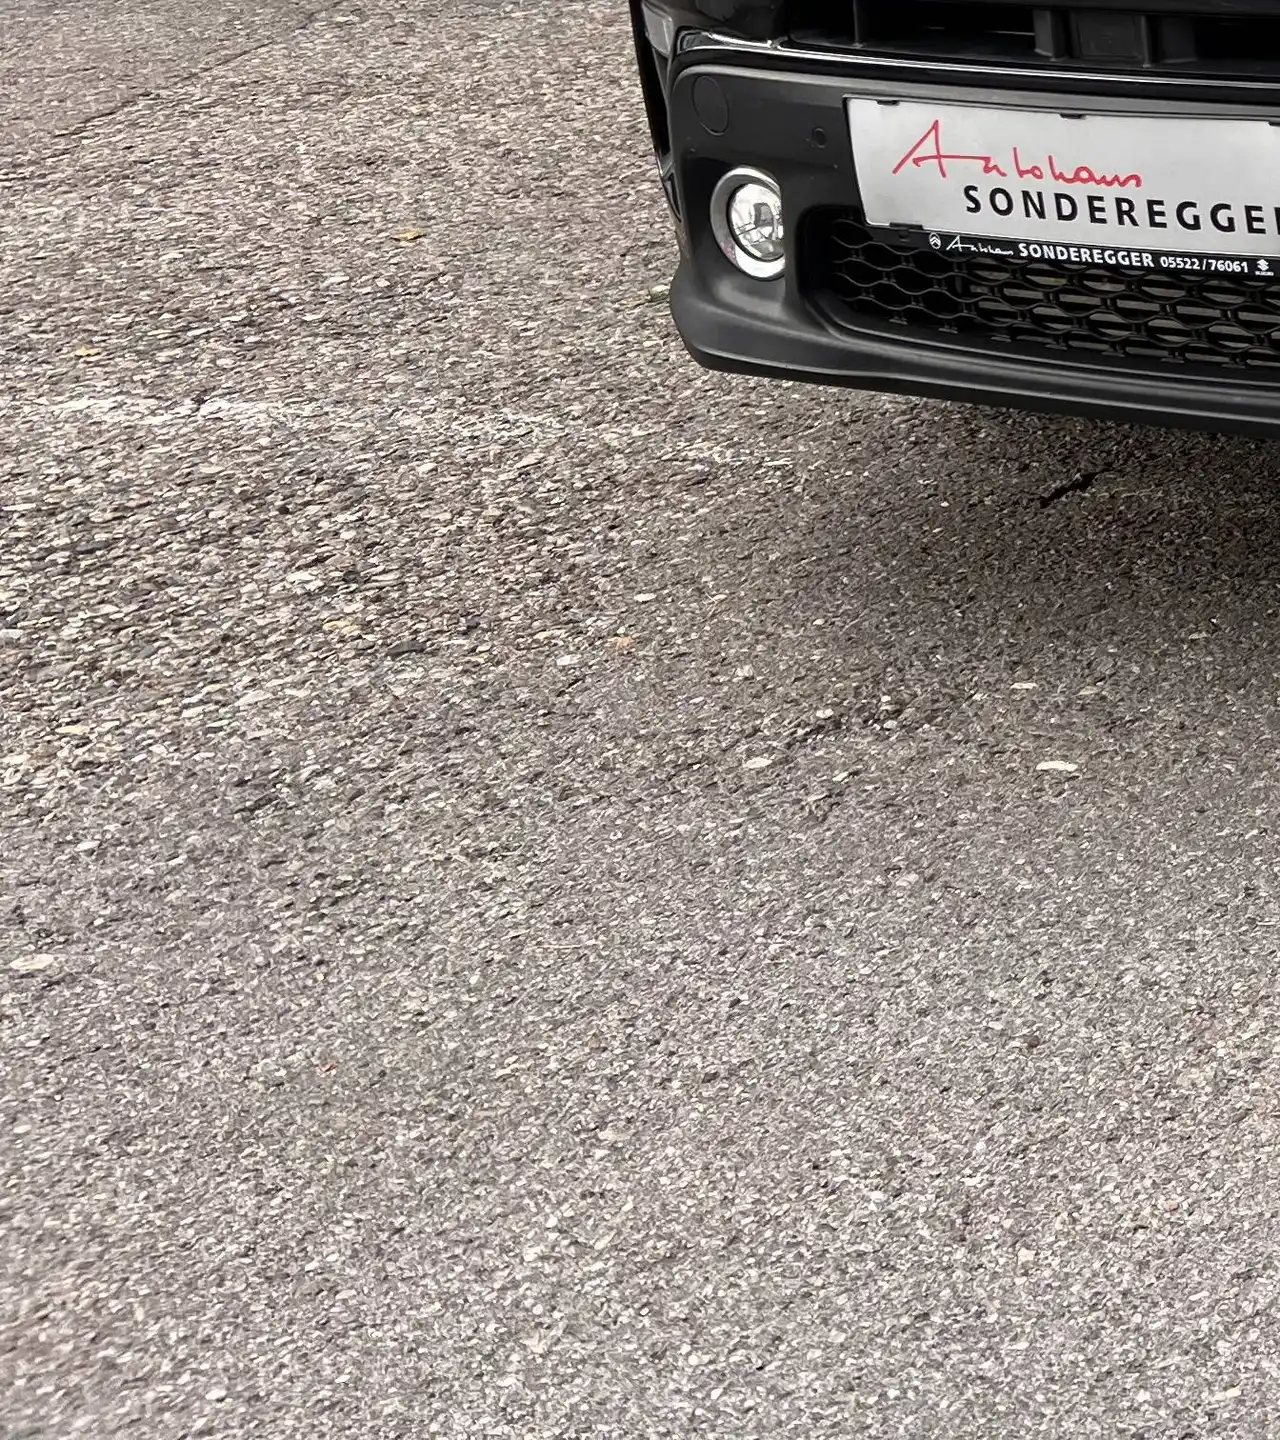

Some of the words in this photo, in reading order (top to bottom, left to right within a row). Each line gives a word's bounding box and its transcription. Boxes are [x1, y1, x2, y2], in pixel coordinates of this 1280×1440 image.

[893, 119, 1143, 189] Autohaus
[1018, 242, 1155, 268] SONDEREGGER
[1160, 257, 1249, 274] 05522/76061
